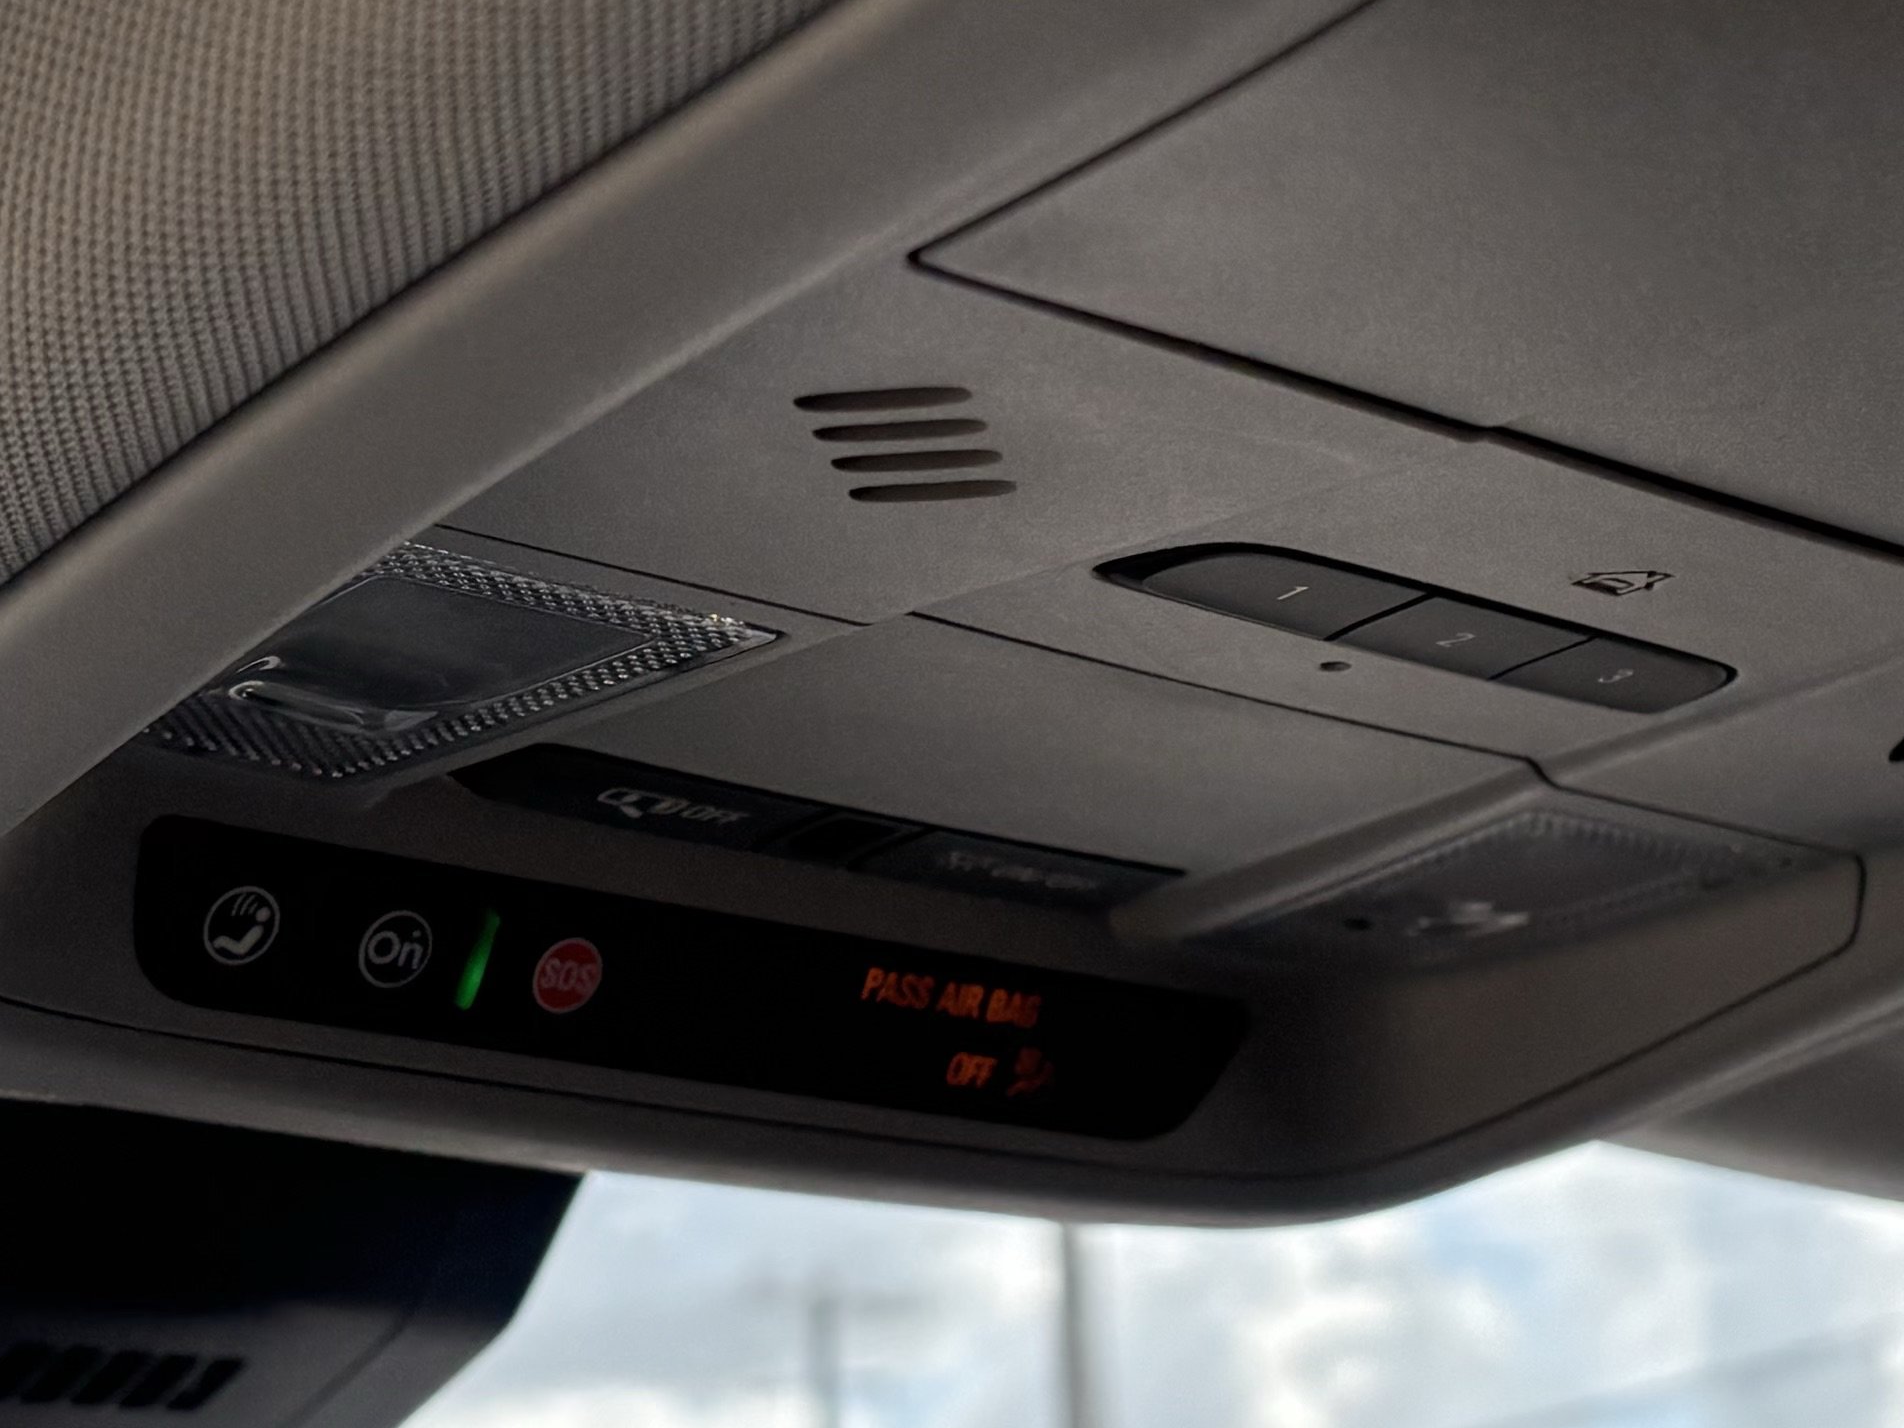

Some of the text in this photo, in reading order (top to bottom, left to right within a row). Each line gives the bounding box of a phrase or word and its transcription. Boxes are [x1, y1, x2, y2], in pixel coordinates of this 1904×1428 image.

[1277, 586, 1309, 600] 1
[1436, 632, 1476, 648] 2
[542, 957, 599, 996] SOS
[861, 968, 1042, 1029] PASS AIR BAG
[946, 1051, 999, 1089] OFF
